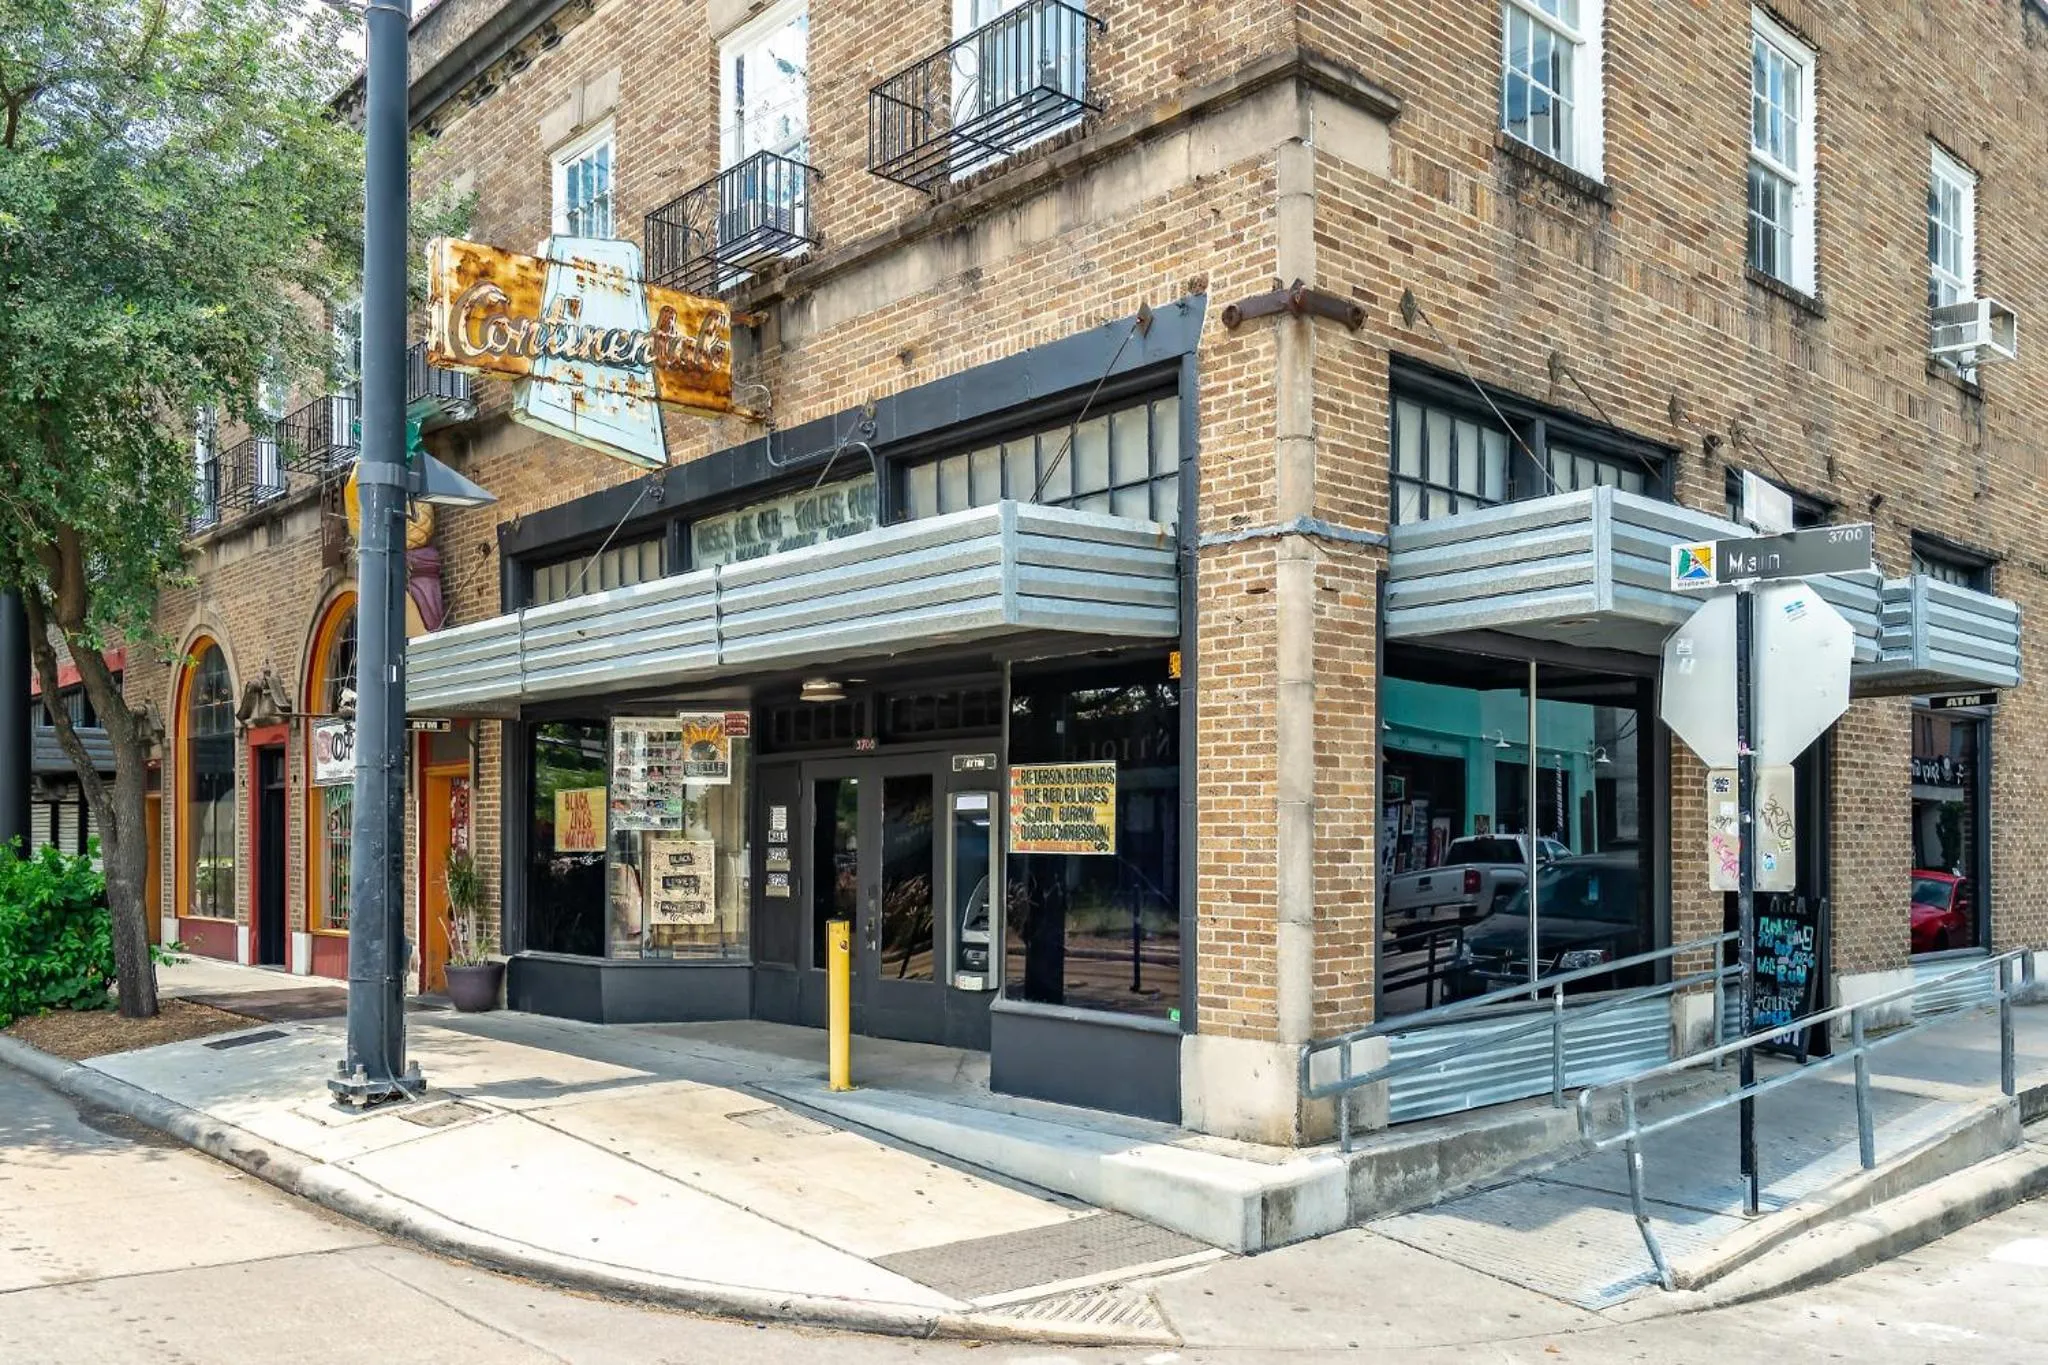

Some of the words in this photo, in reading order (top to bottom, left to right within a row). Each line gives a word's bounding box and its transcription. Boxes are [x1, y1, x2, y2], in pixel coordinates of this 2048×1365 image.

[449, 280, 729, 373] Continental
[1828, 529, 1863, 544] 3700
[1728, 551, 1781, 574] Main
[1945, 695, 1981, 707] ATM
[412, 721, 438, 730] ATM
